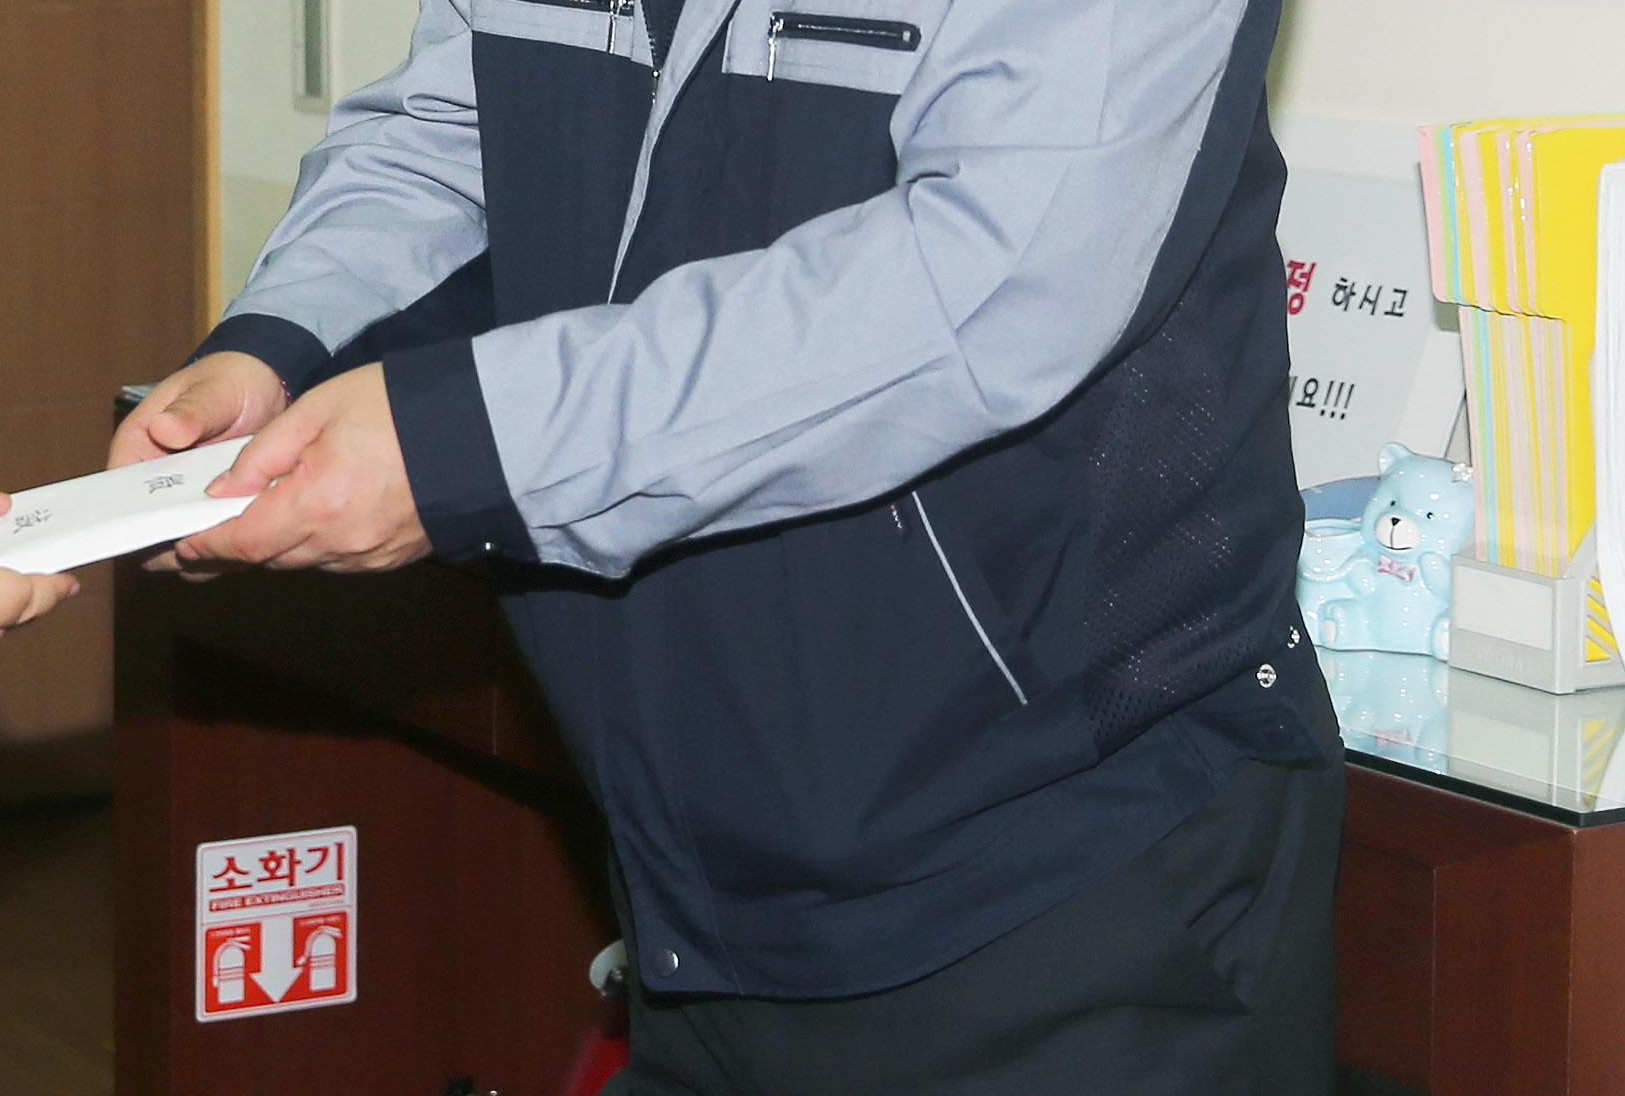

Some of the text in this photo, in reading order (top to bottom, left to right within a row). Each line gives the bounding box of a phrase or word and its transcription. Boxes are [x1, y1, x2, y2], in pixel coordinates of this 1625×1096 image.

[1332, 277, 1407, 316] 하시고
[1289, 376, 1354, 419] 요!!!
[209, 842, 344, 893] 소화기
[212, 898, 241, 910] FIRE
[245, 887, 343, 907] EXTINGUISHER
